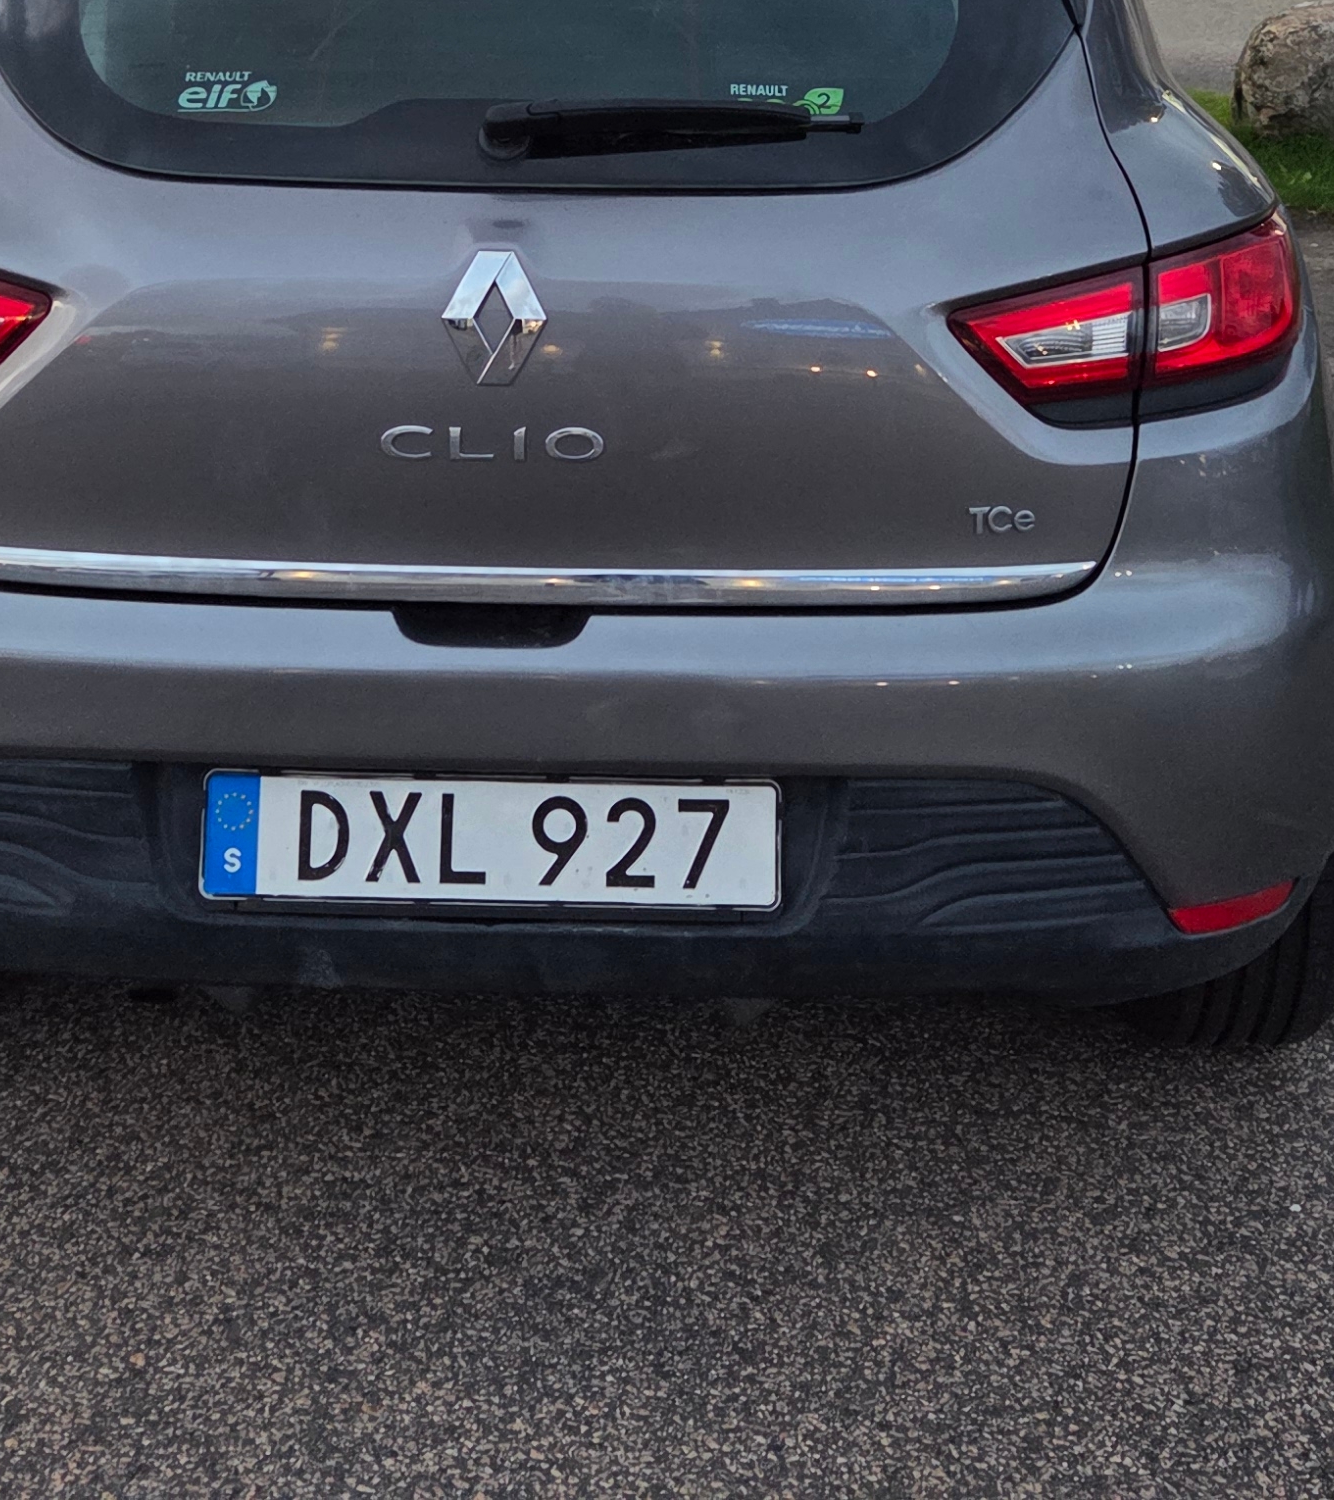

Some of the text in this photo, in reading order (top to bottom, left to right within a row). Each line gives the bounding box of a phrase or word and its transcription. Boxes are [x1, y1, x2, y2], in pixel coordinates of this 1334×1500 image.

[185, 71, 252, 82] RENAULT
[178, 84, 242, 108] elf
[730, 84, 788, 96] RENAULT
[381, 425, 604, 460] CLIO
[968, 505, 1036, 534] TCe
[298, 790, 730, 889] DXL 927
[223, 847, 242, 873] S
